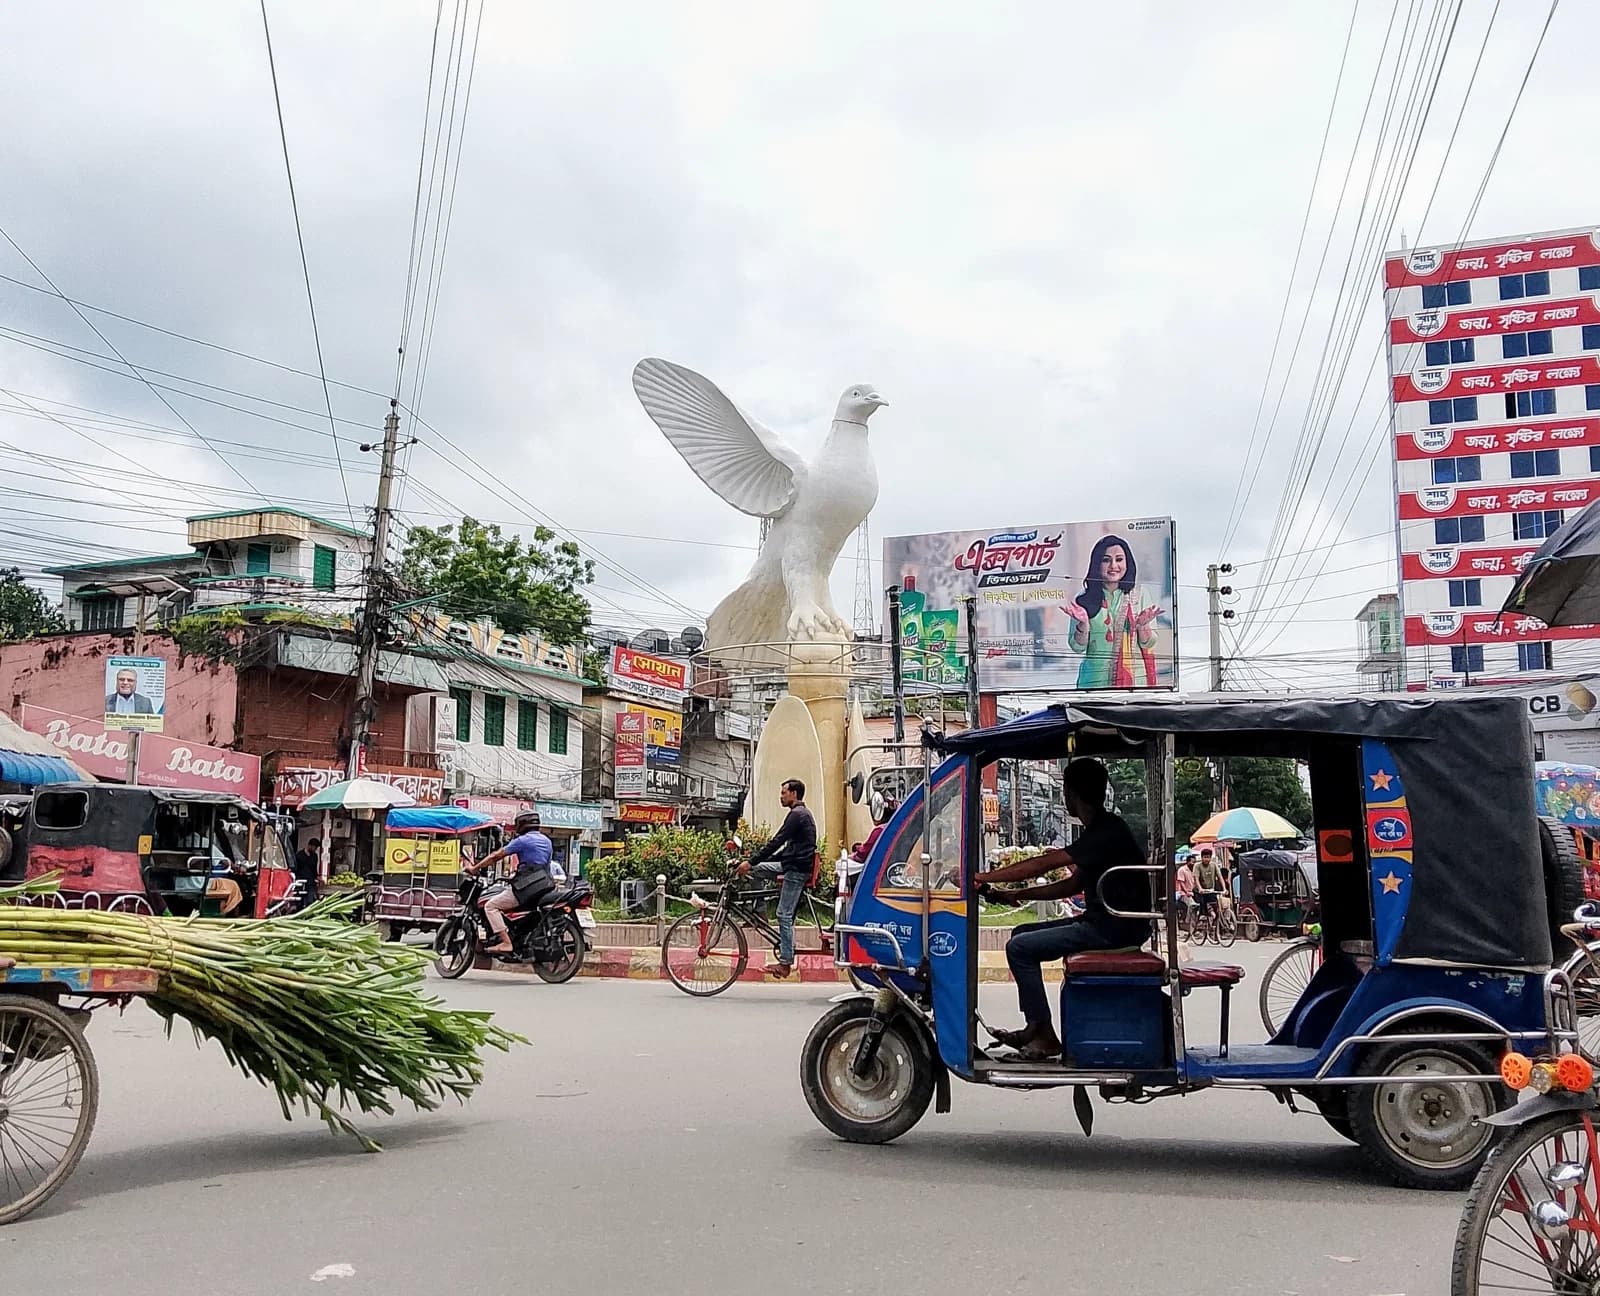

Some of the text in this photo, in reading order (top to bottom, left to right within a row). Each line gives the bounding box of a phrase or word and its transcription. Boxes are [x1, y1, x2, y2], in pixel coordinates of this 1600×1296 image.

[954, 535, 1062, 576] এক্সপার্ট
[46, 720, 128, 761] Bata
[165, 747, 245, 782] Bata
